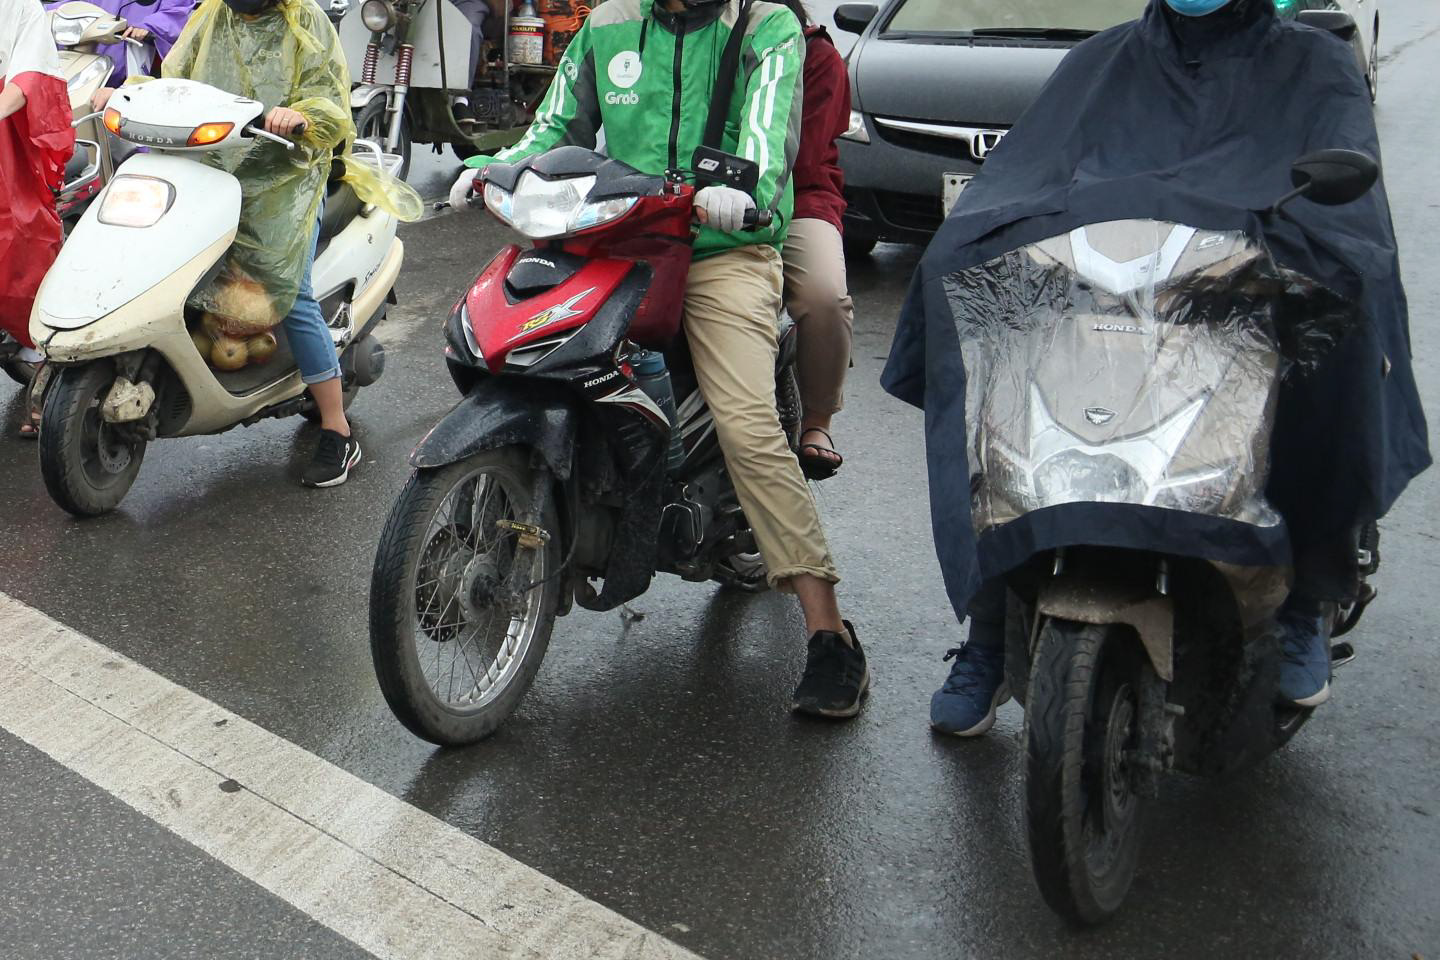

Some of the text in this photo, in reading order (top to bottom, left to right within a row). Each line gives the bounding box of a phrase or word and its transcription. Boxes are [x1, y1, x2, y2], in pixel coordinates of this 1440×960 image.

[605, 90, 639, 105] Grab
[129, 132, 174, 144] HONDA
[519, 257, 556, 269] HONDA
[1093, 323, 1148, 335] HONDA
[583, 370, 620, 388] HONDA
